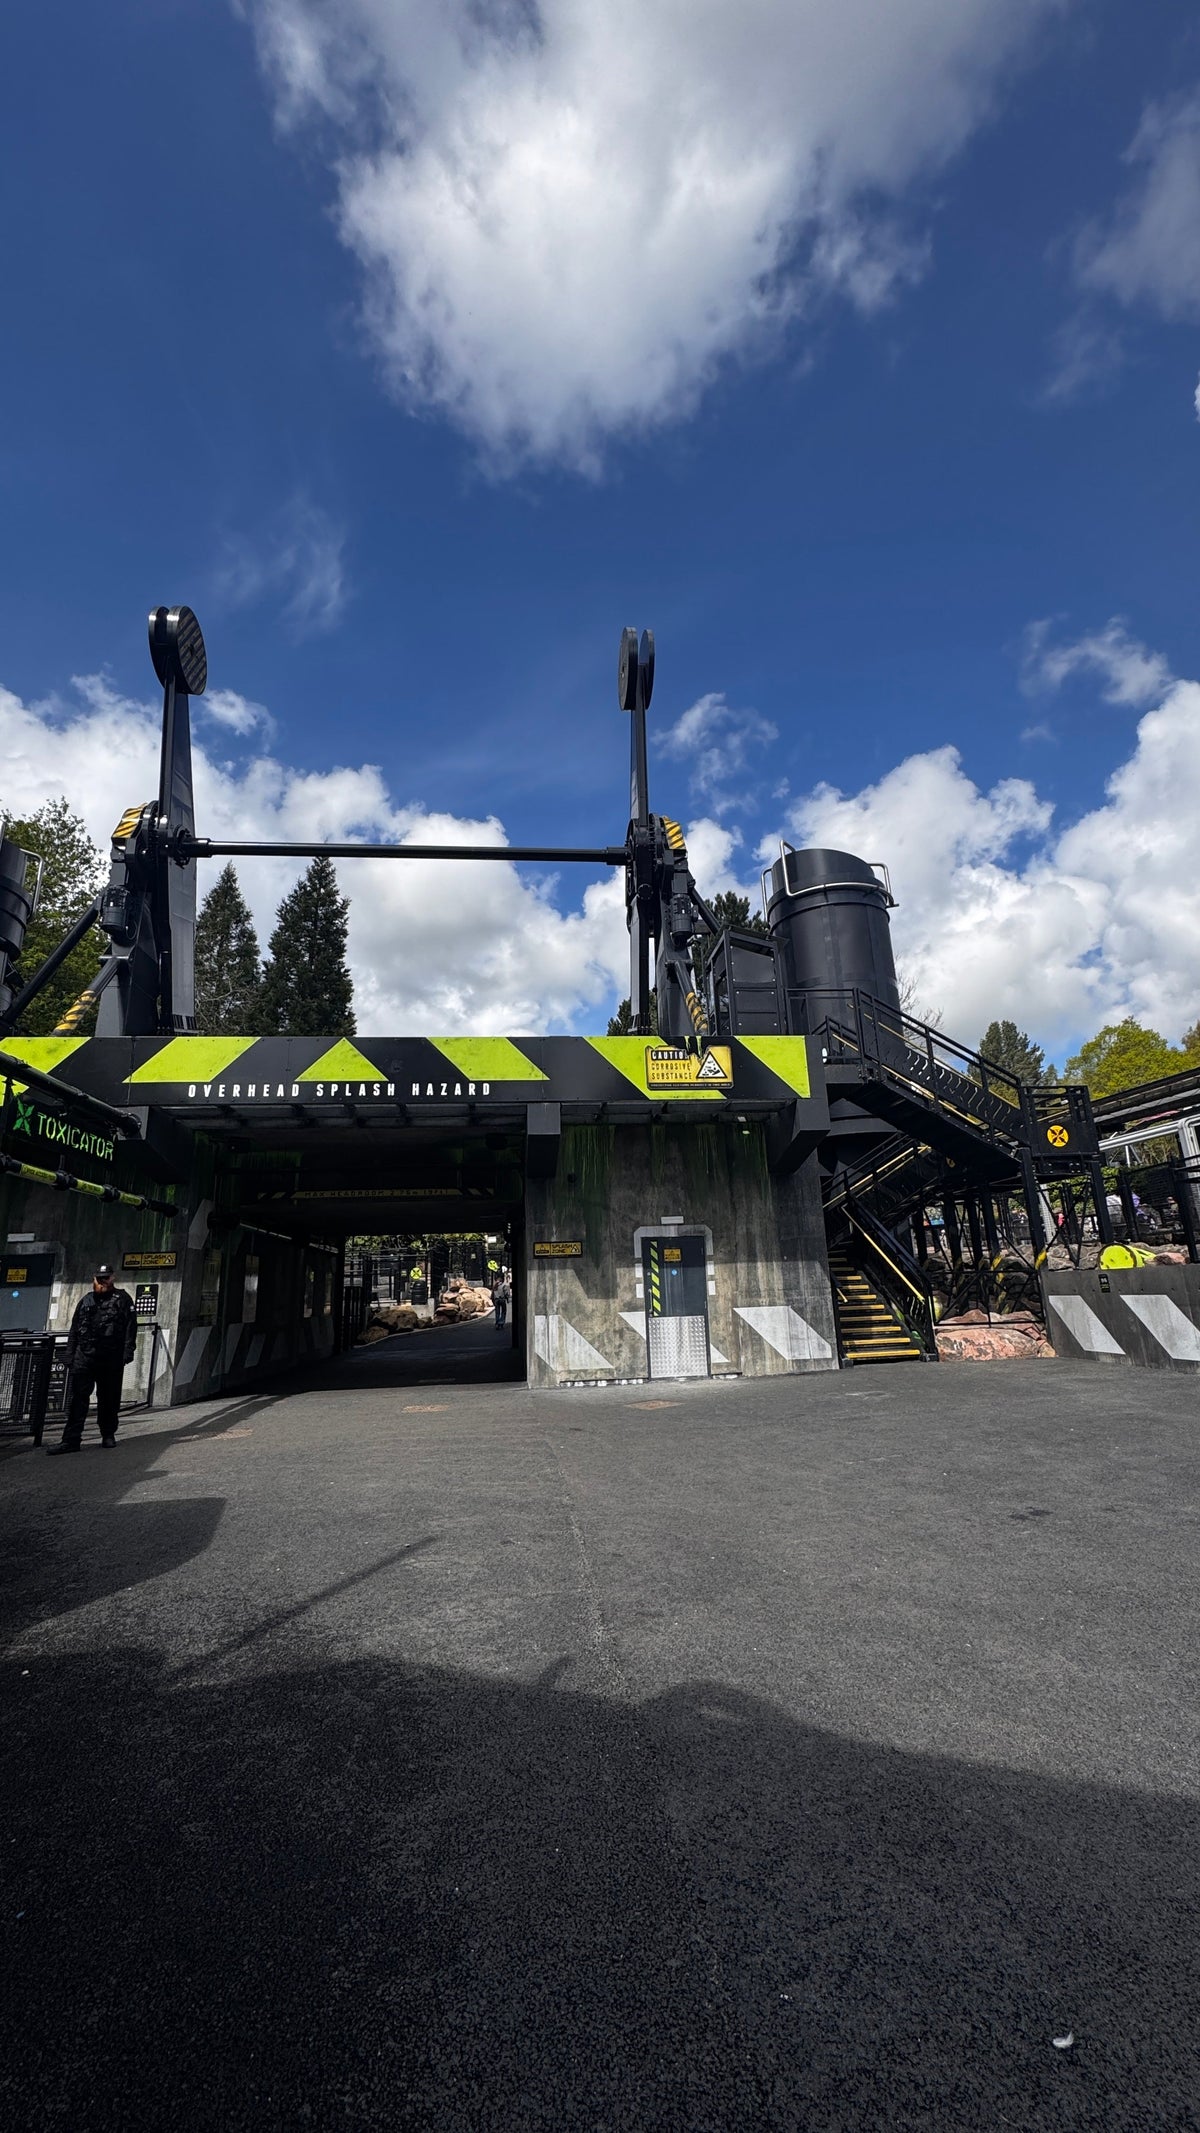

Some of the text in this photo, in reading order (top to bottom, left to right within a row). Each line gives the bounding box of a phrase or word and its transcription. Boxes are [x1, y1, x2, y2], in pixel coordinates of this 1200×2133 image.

[651, 1062, 691, 1071] CORROSIVE
[651, 1072, 692, 1080] SUBSTANCE
[188, 1082, 491, 1098] OVERHEAD SPLASH HAZARD
[38, 1112, 114, 1161] TOXICATOR
